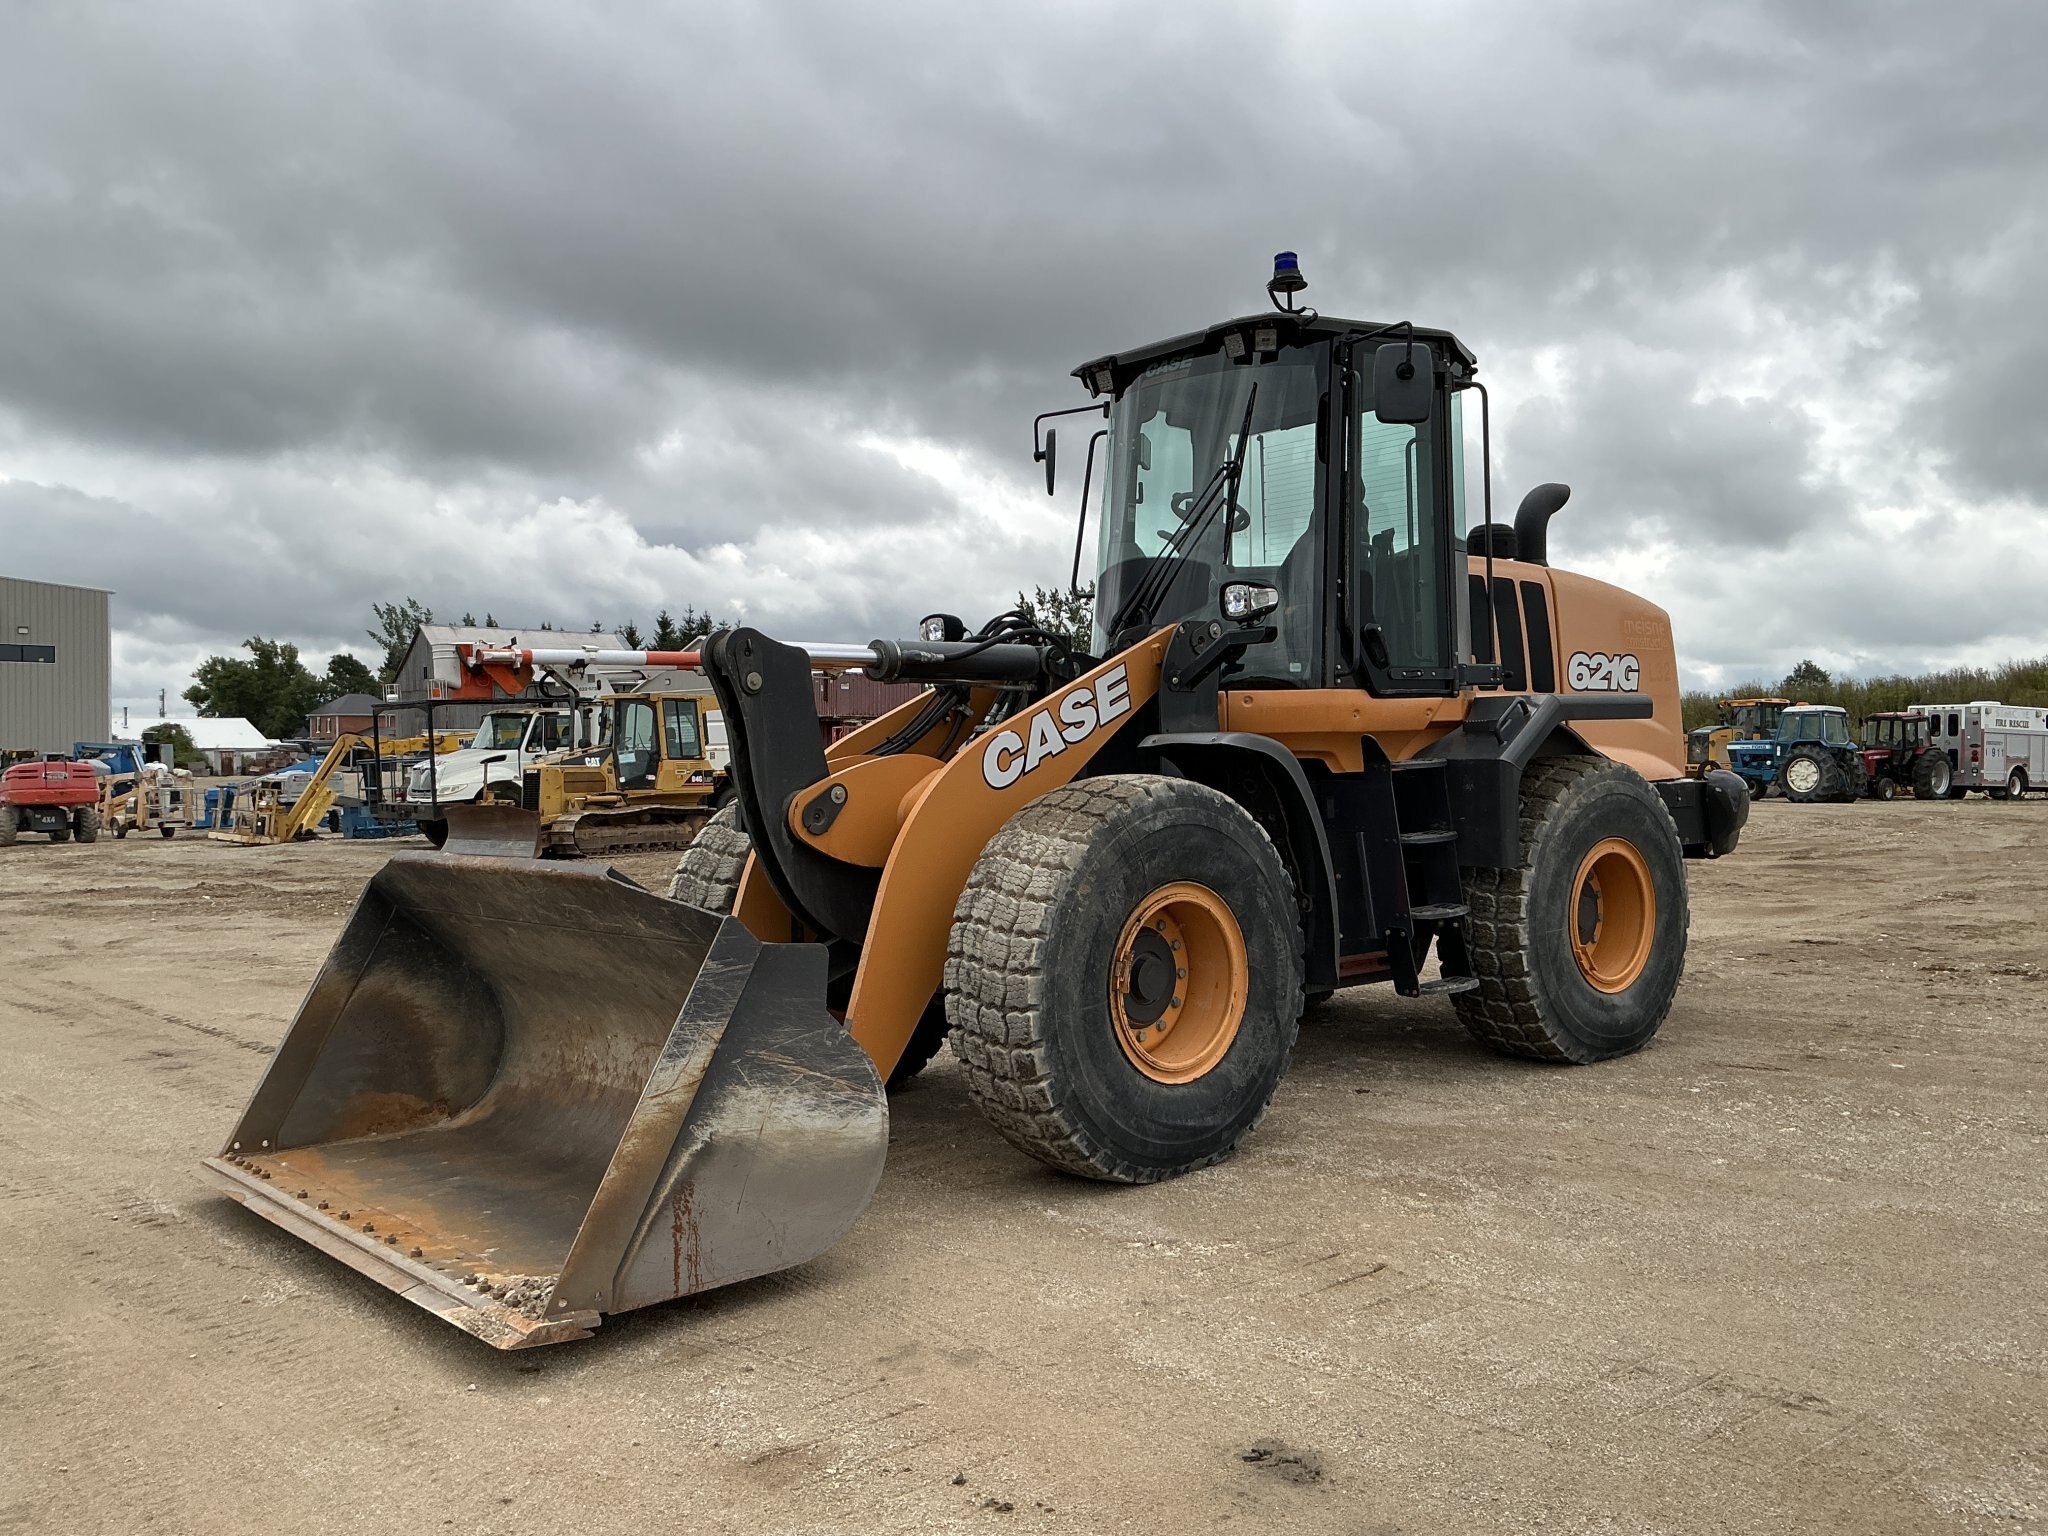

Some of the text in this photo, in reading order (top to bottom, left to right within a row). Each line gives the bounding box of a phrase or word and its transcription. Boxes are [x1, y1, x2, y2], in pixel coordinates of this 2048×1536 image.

[1146, 354, 1193, 377] CASE
[1568, 651, 1640, 692] 621G
[982, 661, 1131, 790] CASE
[1995, 719, 2030, 729] FIRE RESCUE
[585, 757, 600, 767] CAT
